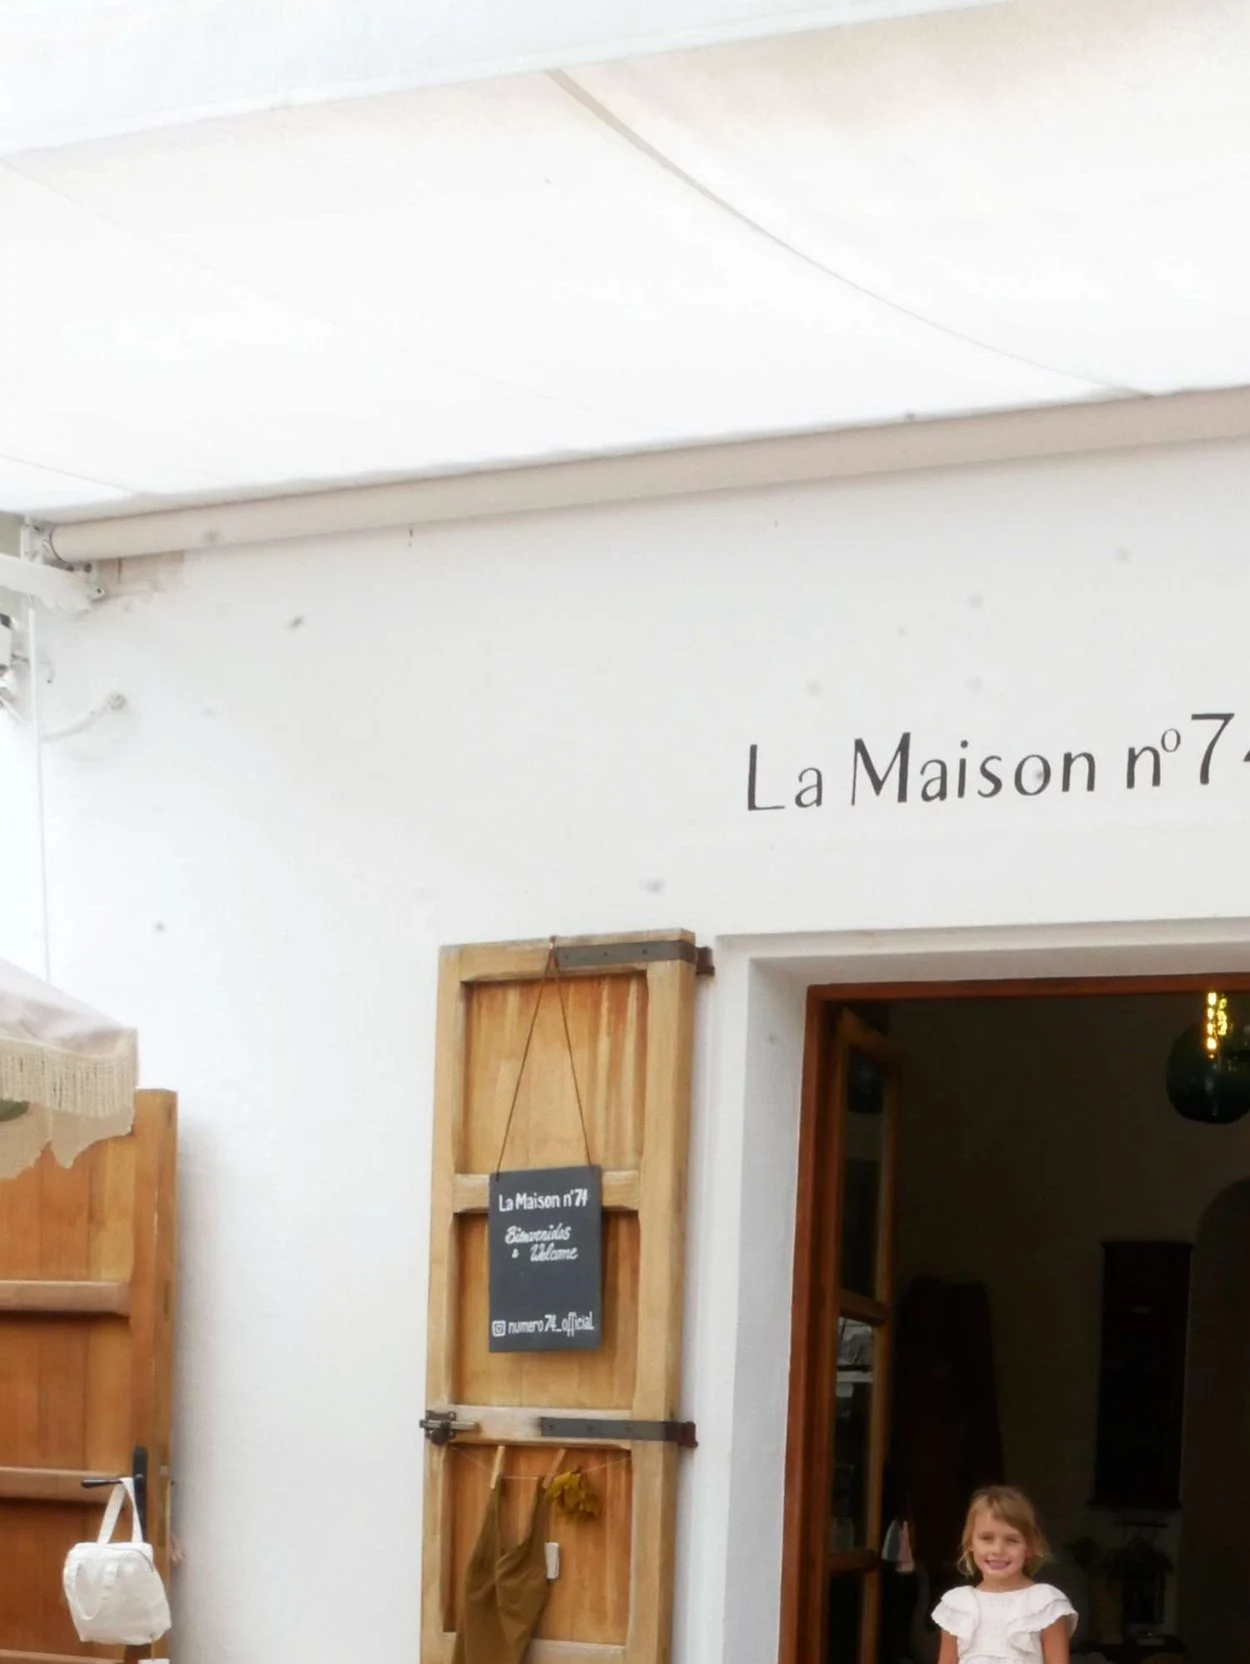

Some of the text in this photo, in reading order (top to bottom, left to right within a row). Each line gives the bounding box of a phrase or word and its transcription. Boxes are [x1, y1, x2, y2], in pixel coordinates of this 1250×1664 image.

[746, 743, 824, 811] La
[850, 730, 1097, 807] Maison
[499, 1194, 514, 1212] La
[515, 1191, 560, 1210] Maison
